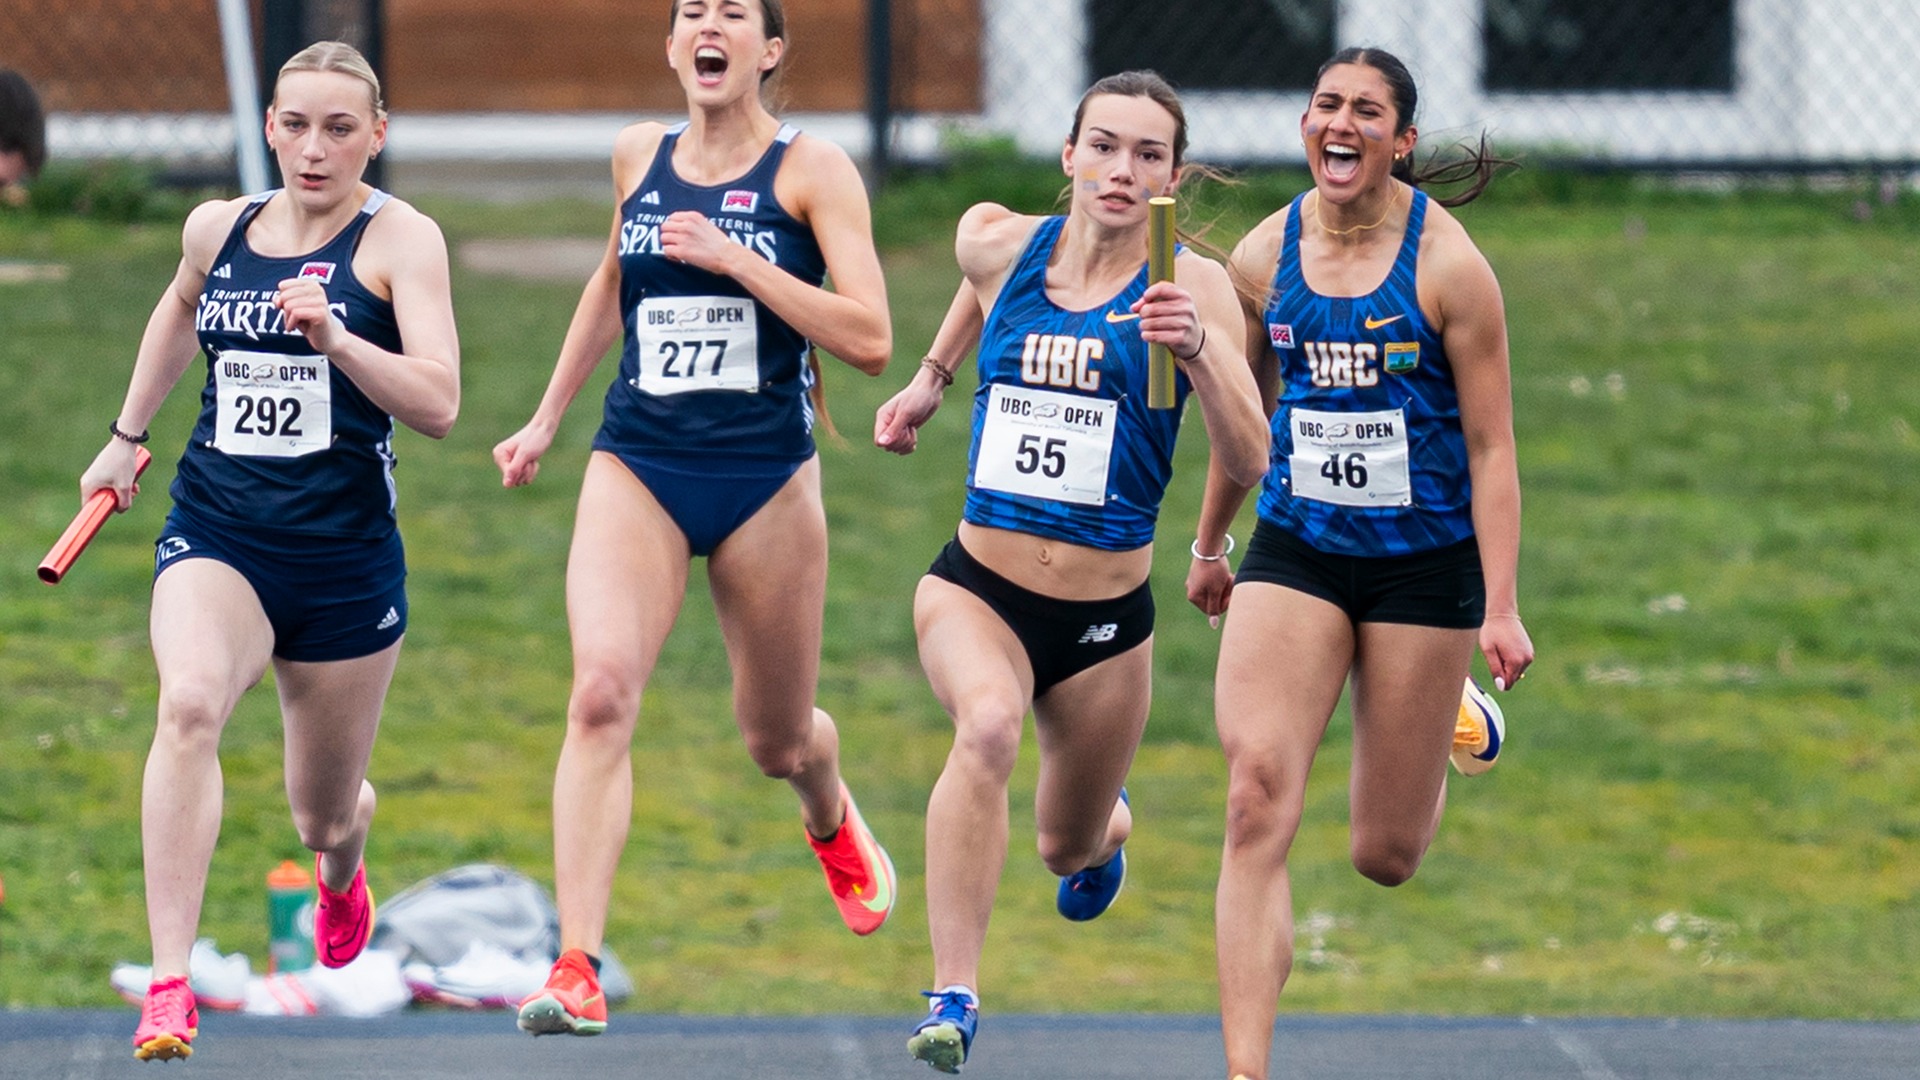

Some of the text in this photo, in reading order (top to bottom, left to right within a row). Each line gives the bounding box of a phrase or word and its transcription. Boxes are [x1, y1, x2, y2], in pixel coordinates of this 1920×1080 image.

[705, 217, 754, 232] STERN
[211, 289, 258, 300] TRINITY
[648, 307, 744, 325] UBC OPEN
[224, 362, 317, 382] UBC OPEN
[659, 339, 728, 378] 277
[1021, 333, 1105, 392] UBC
[1304, 341, 1379, 387] UBC
[234, 394, 303, 437] 292
[1000, 397, 1032, 416] UBC
[1064, 407, 1103, 427] OPEN
[1299, 421, 1394, 440] UBC OPEN
[1015, 434, 1067, 479] 55
[1320, 452, 1369, 489] 46
